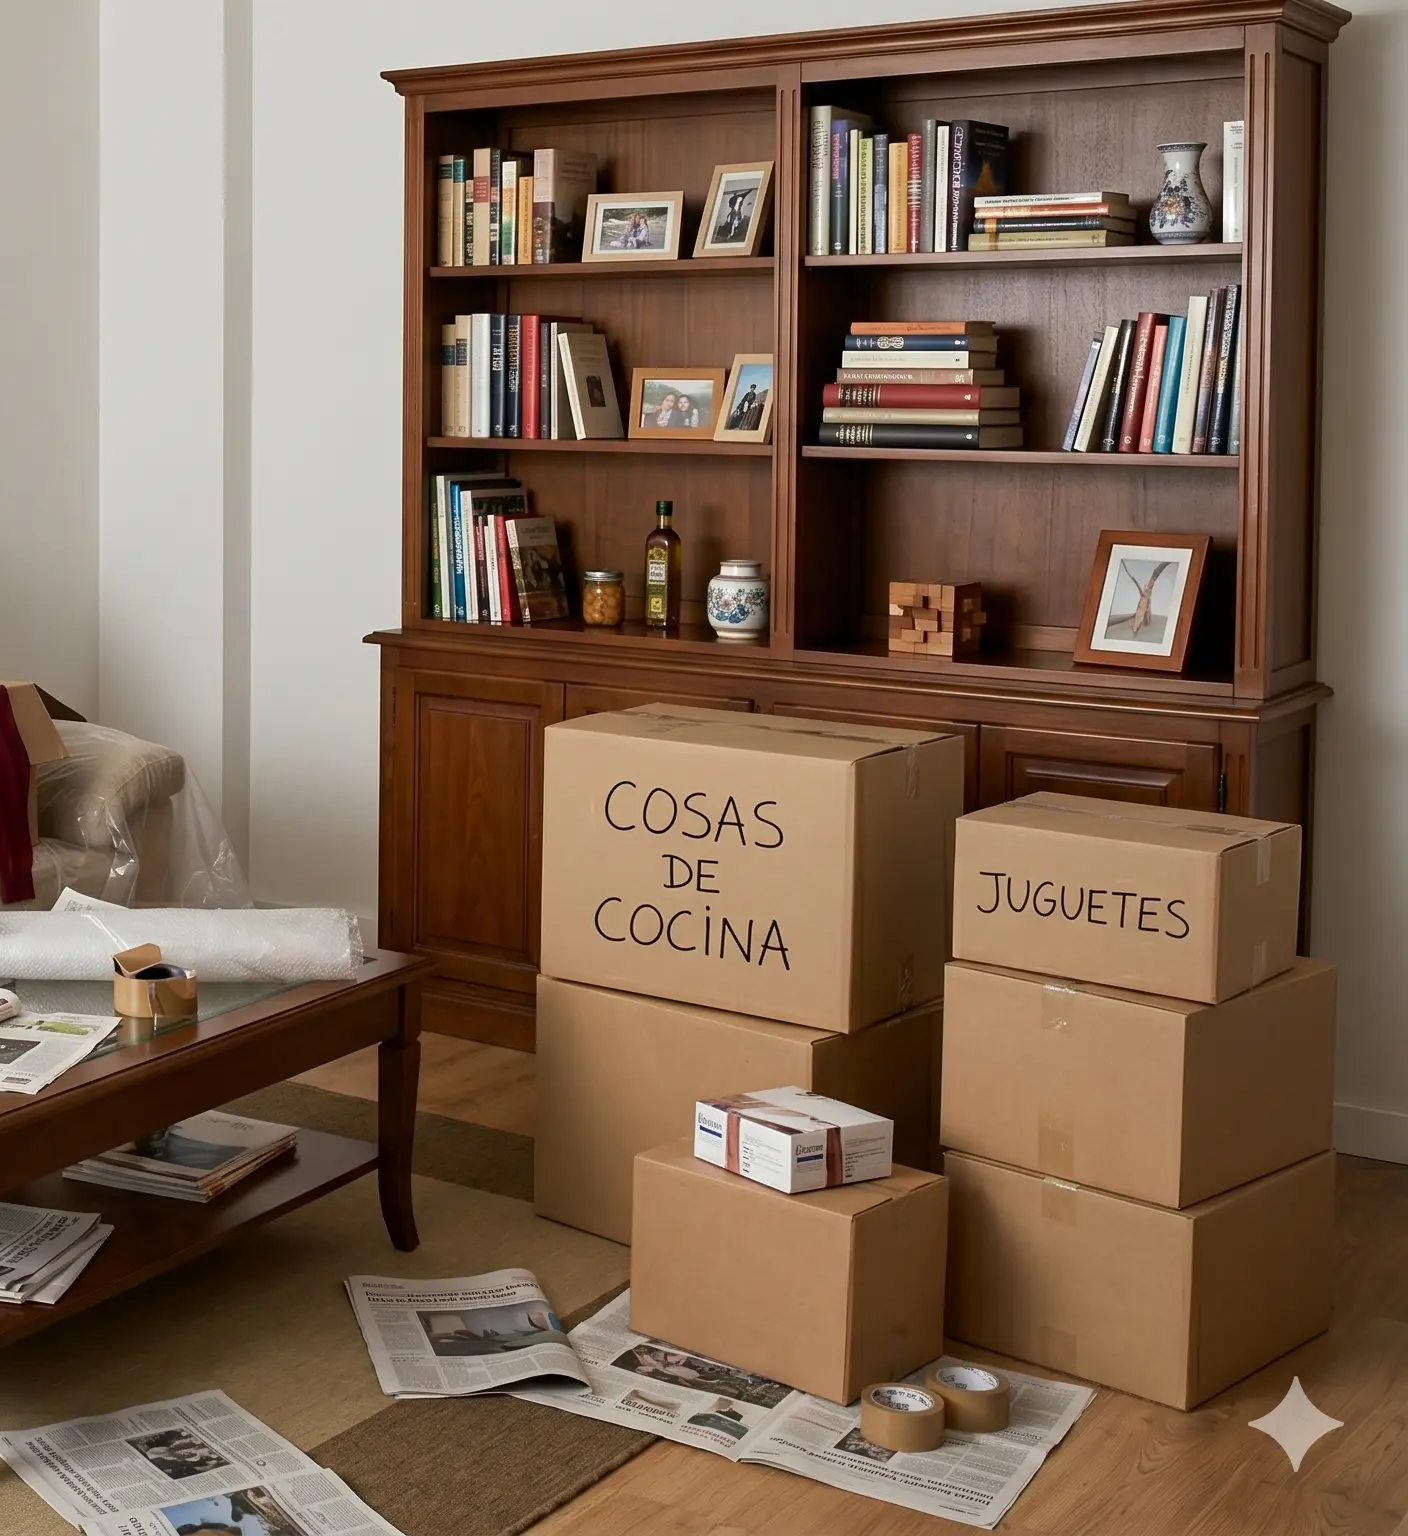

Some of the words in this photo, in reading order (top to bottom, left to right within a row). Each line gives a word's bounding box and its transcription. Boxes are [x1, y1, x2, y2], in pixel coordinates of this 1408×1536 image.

[604, 780, 784, 849] COSAS
[661, 853, 721, 894] DE
[976, 871, 1191, 940] JUGUETES
